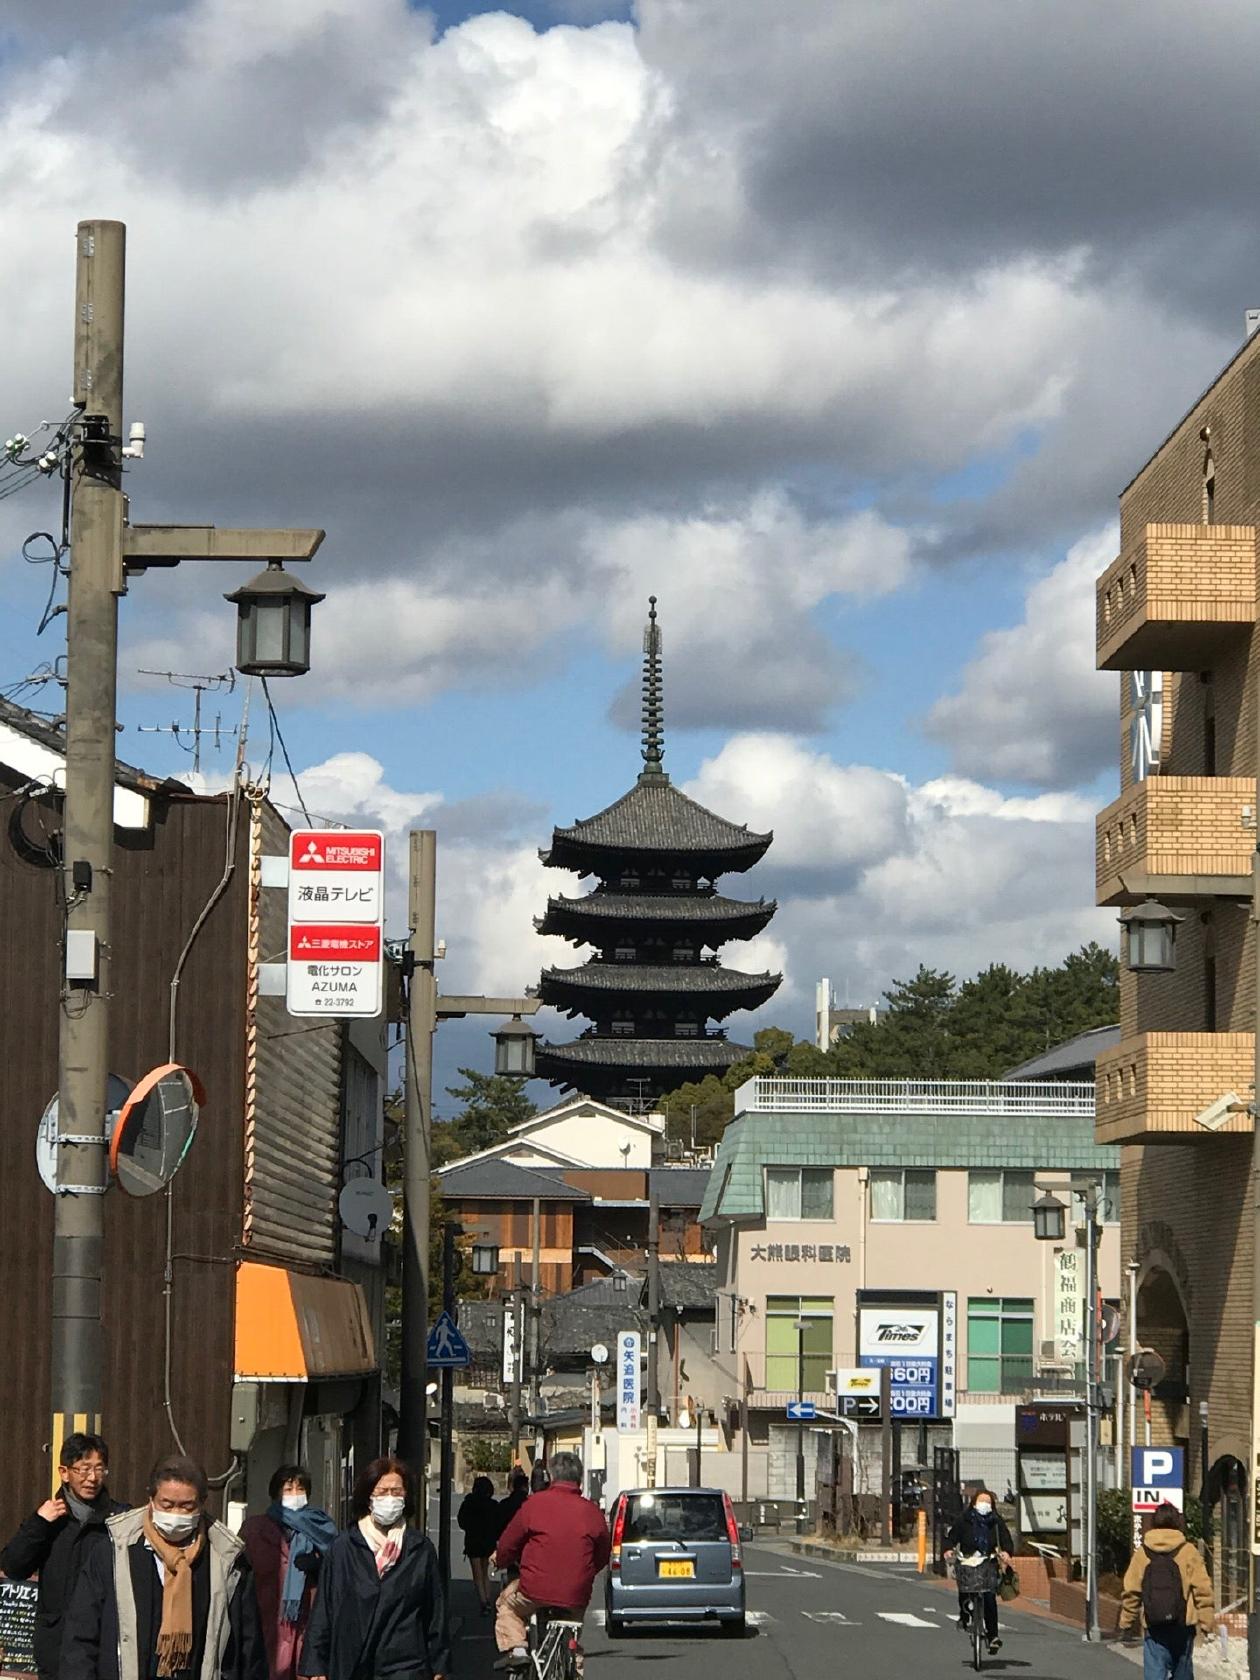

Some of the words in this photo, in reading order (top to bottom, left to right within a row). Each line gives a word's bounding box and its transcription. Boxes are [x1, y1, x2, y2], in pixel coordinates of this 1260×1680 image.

[326, 846, 375, 857] MITSUBISHI
[326, 856, 368, 864] ELECTRIC
[298, 885, 374, 902] 液晶テレビ
[311, 938, 374, 950] 三菱電機ストア
[307, 964, 363, 977] 電化サロン
[311, 981, 358, 993] AZUMA
[750, 1243, 851, 1263] 大熊眼科医院
[877, 1326, 921, 1341] Times
[890, 1367, 930, 1383] 60円
[843, 1397, 857, 1416] P
[890, 1396, 930, 1412] 00円
[1143, 1451, 1173, 1485] P
[1137, 1490, 1160, 1503] IN
